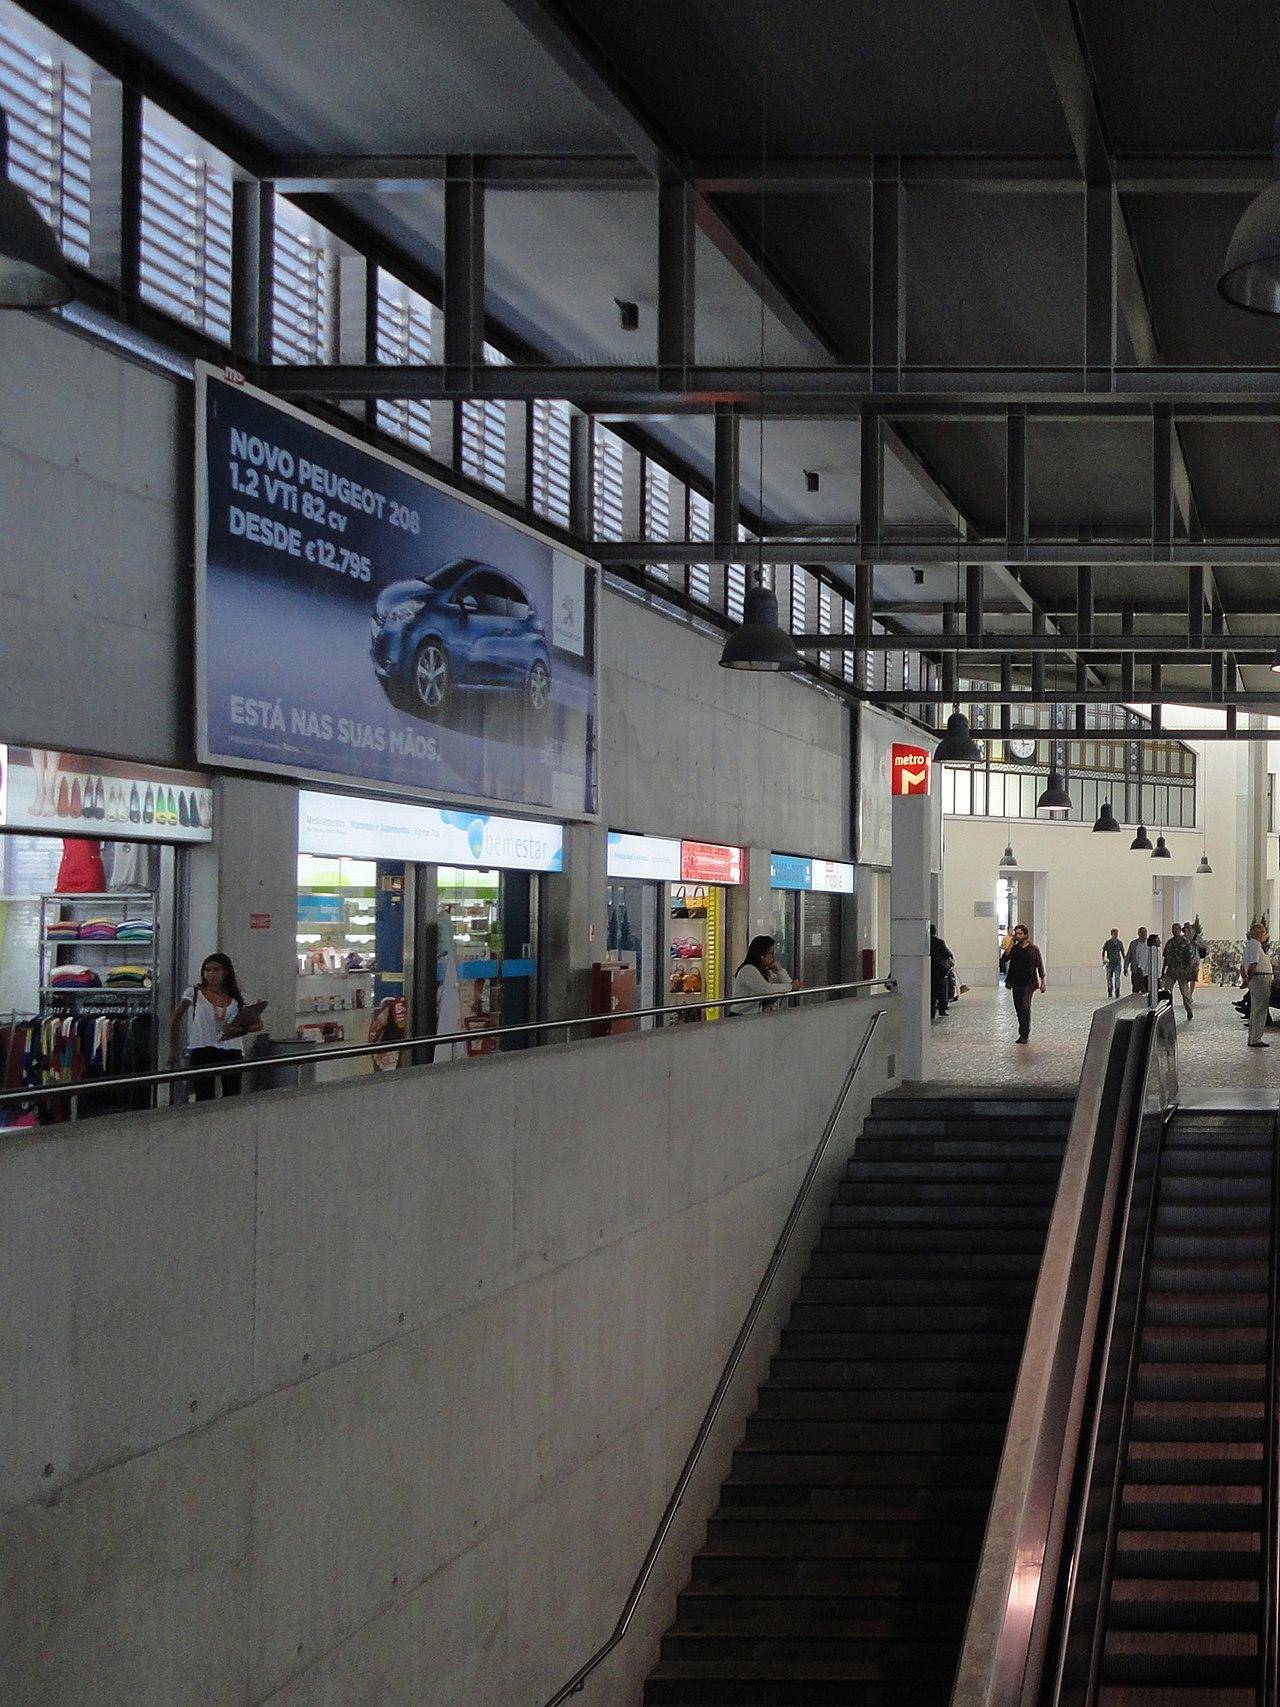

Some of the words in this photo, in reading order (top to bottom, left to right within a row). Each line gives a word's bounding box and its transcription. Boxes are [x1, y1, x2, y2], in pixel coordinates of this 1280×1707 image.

[229, 462, 259, 498] 1.2
[263, 474, 298, 513] VTi
[302, 491, 326, 525] 82
[230, 427, 295, 479] NOVO
[299, 457, 386, 519] PEUGEOT
[388, 500, 421, 534] 208
[229, 505, 302, 557] DESDE
[305, 538, 372, 583] €12.795
[230, 694, 286, 732] ESTÁ
[290, 707, 334, 741] NAS
[337, 717, 387, 752] SUAS
[389, 726, 442, 762] MÃOS.
[895, 753, 925, 766] metro
